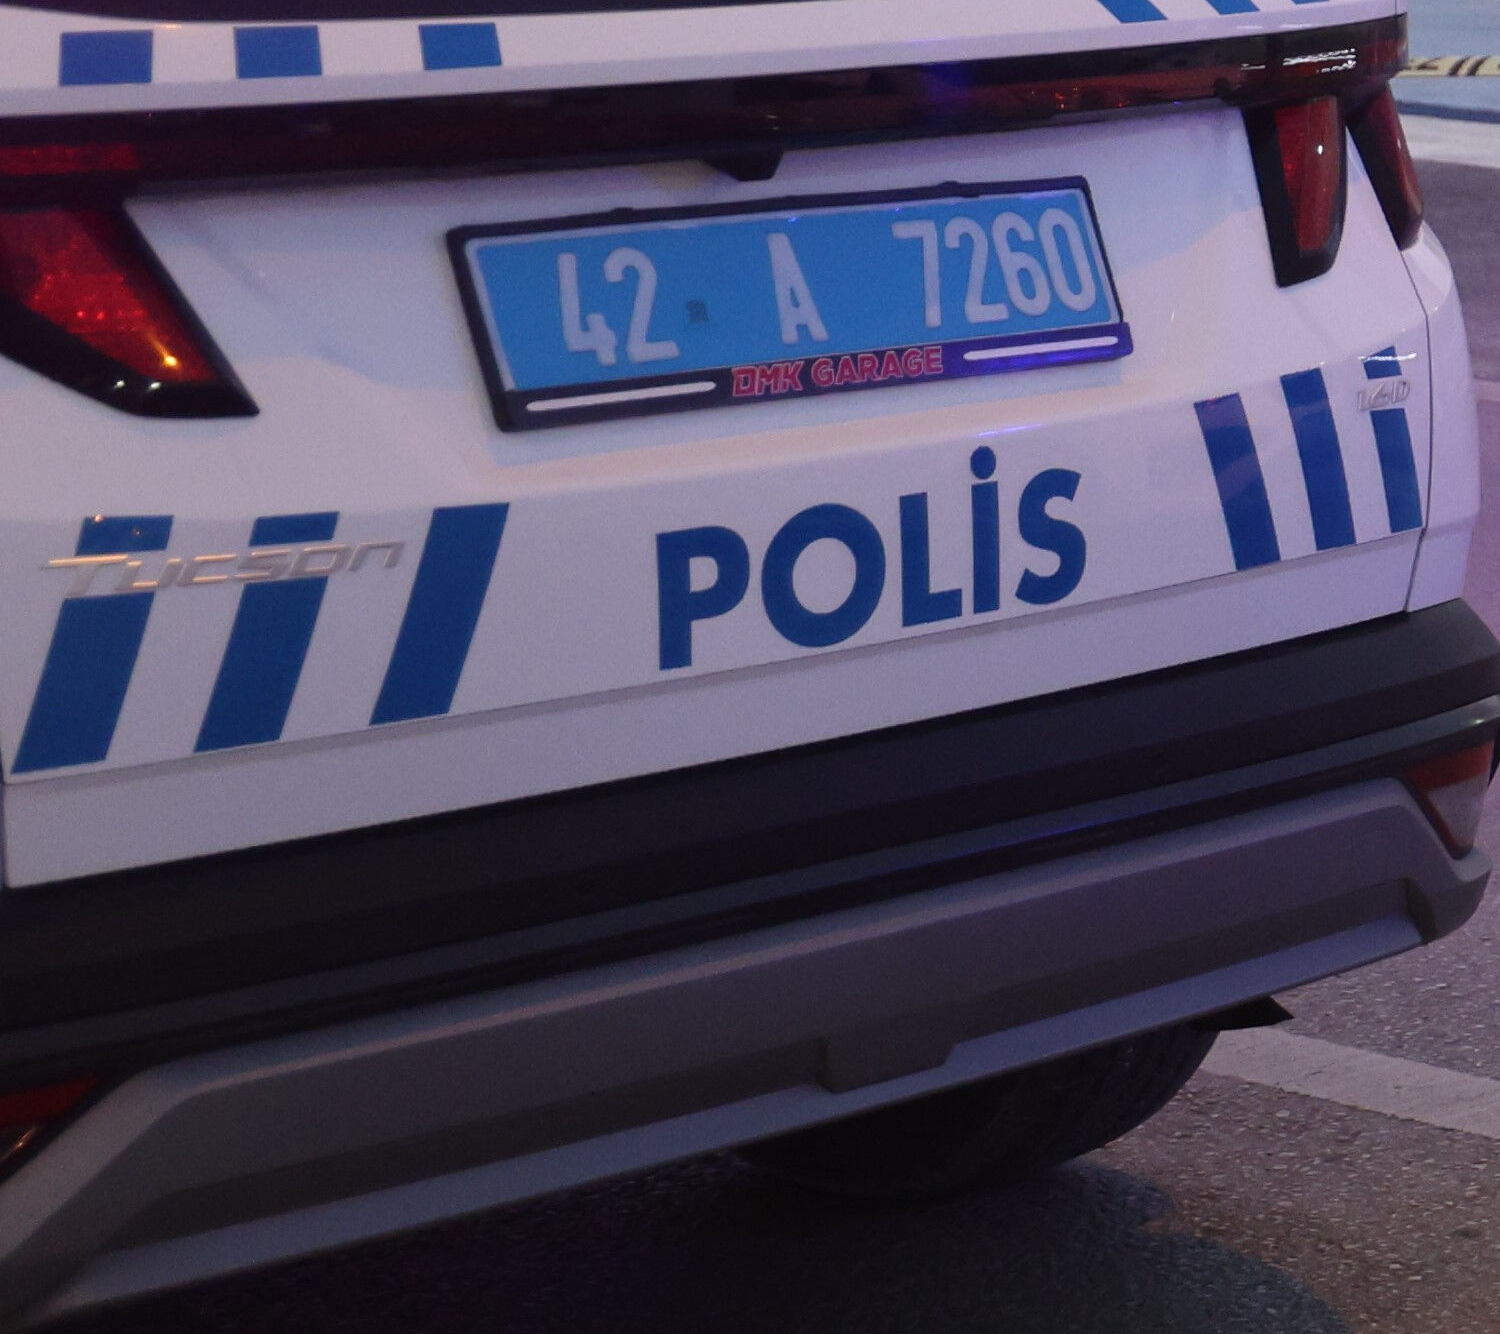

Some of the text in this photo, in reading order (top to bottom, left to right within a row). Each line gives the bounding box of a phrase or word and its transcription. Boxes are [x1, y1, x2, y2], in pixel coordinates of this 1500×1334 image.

[558, 208, 1097, 365] 42 A 7260
[732, 345, 944, 397] DMK GARAGE
[656, 446, 1087, 671] POLİS
